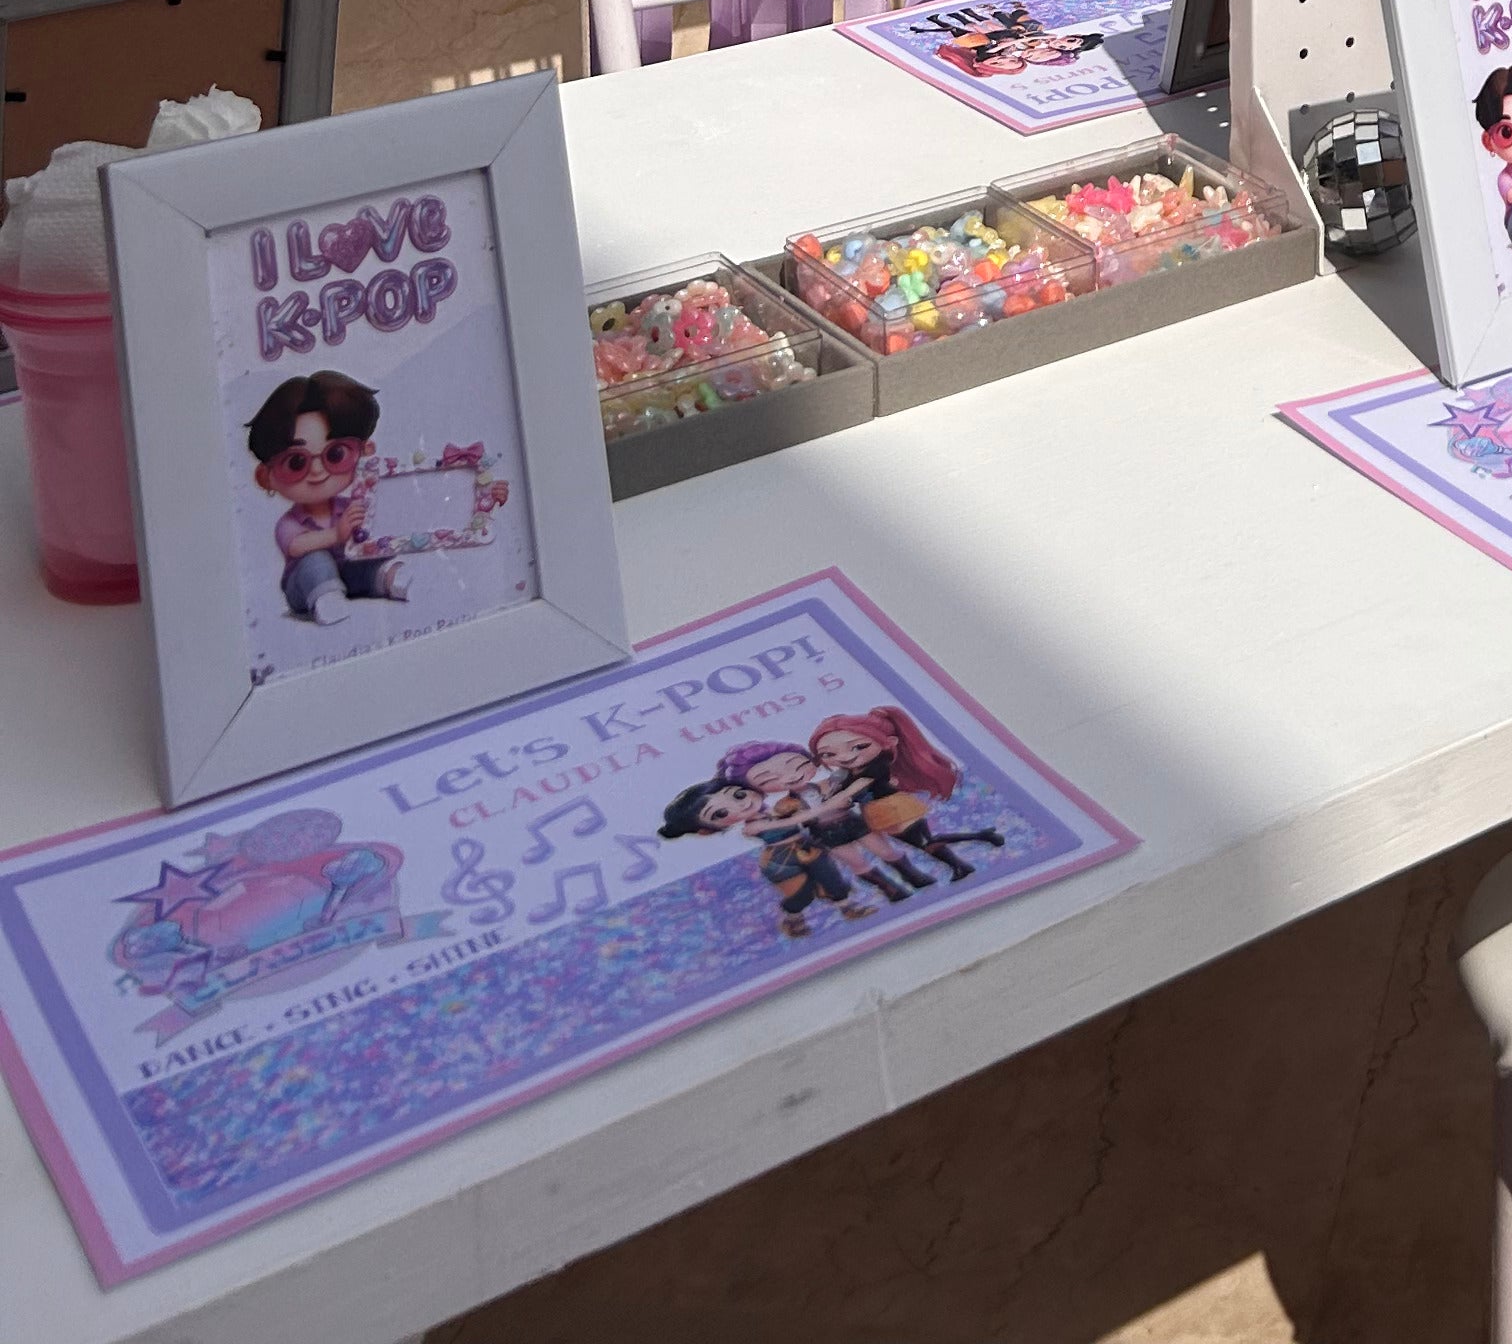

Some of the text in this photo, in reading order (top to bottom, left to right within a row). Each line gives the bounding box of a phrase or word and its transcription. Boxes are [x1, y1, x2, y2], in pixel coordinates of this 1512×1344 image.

[250, 226, 278, 292] I
[379, 635, 826, 814] Let's K-POP!
[449, 672, 845, 829] CLAUDIA turns 5
